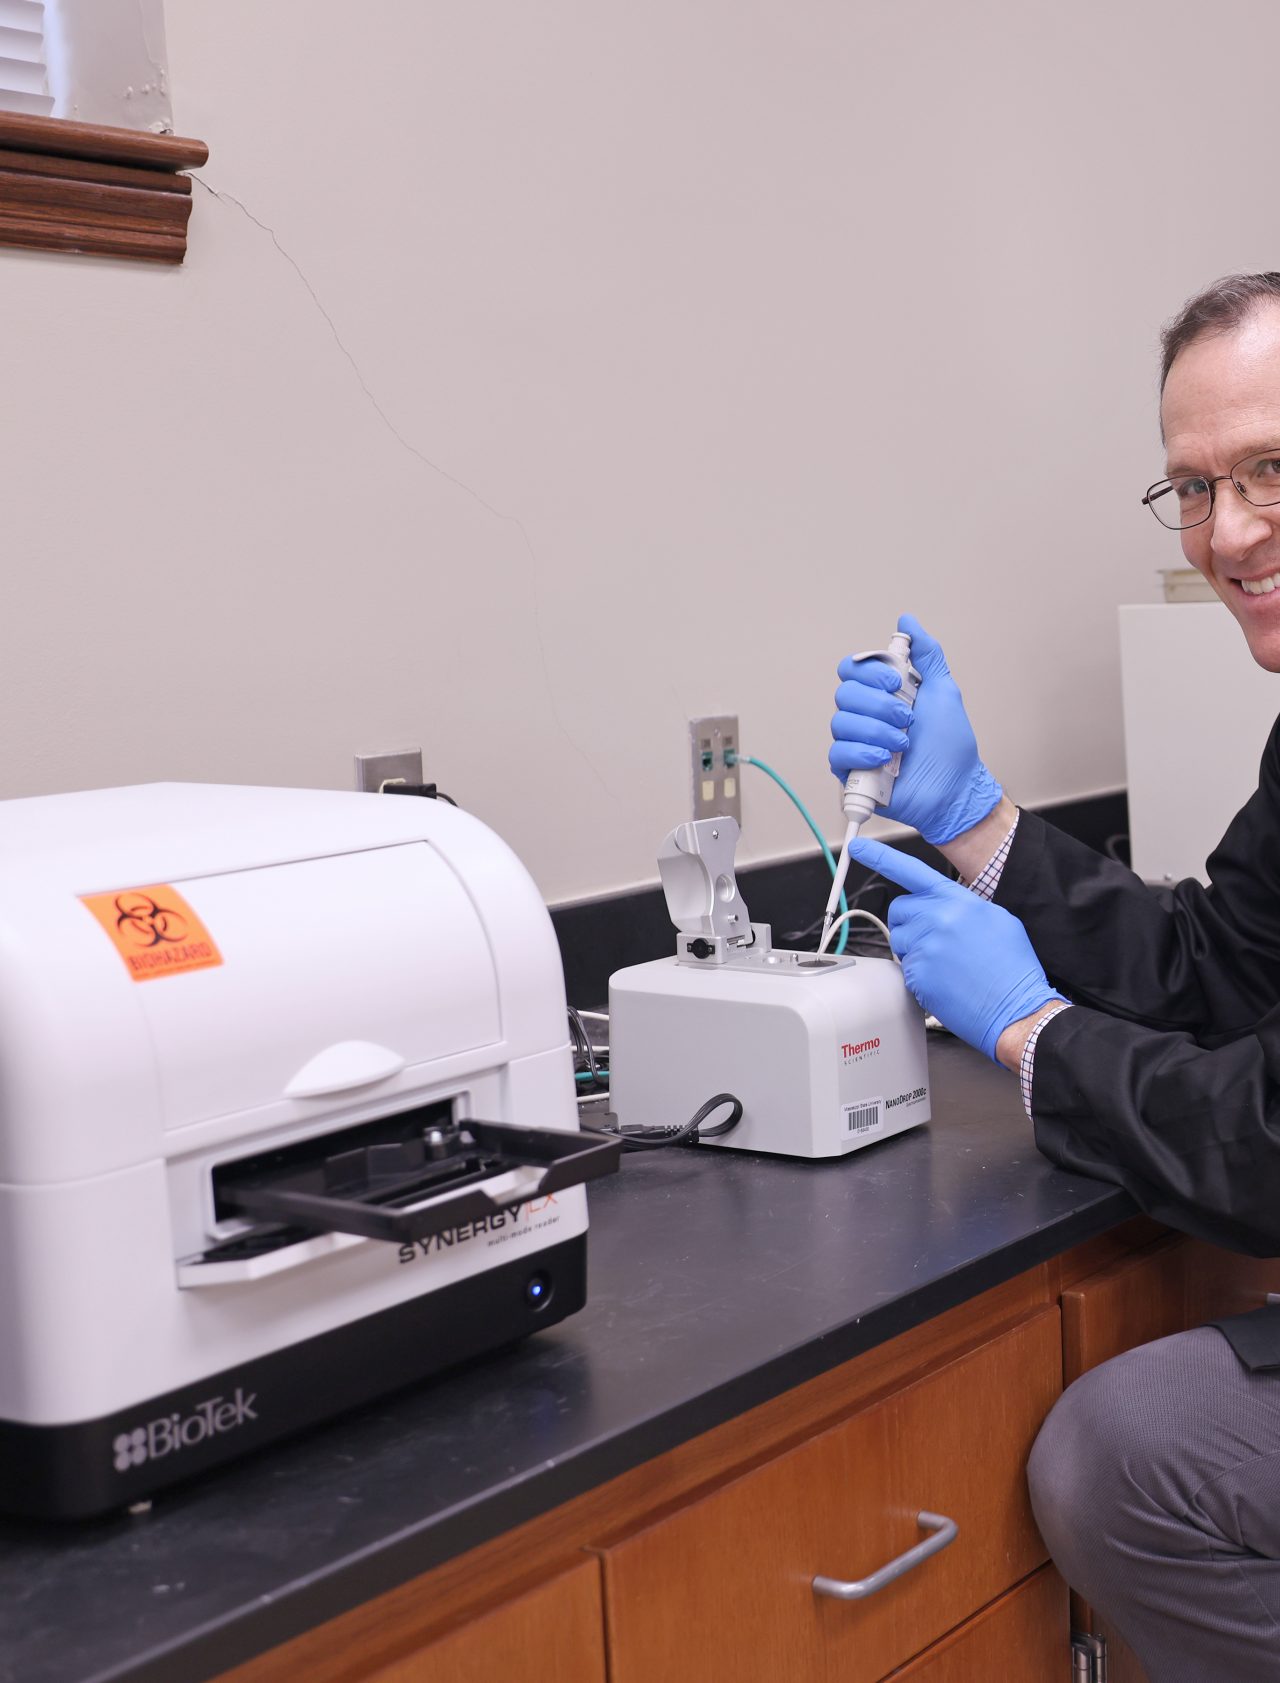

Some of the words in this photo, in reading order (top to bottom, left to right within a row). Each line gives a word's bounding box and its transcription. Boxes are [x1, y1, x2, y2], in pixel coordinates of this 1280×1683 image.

[128, 941, 213, 971] BIOHAZARD
[841, 1037, 880, 1059] Thermo
[398, 1204, 522, 1265] SYNERGY
[147, 1387, 258, 1460] BioTek
